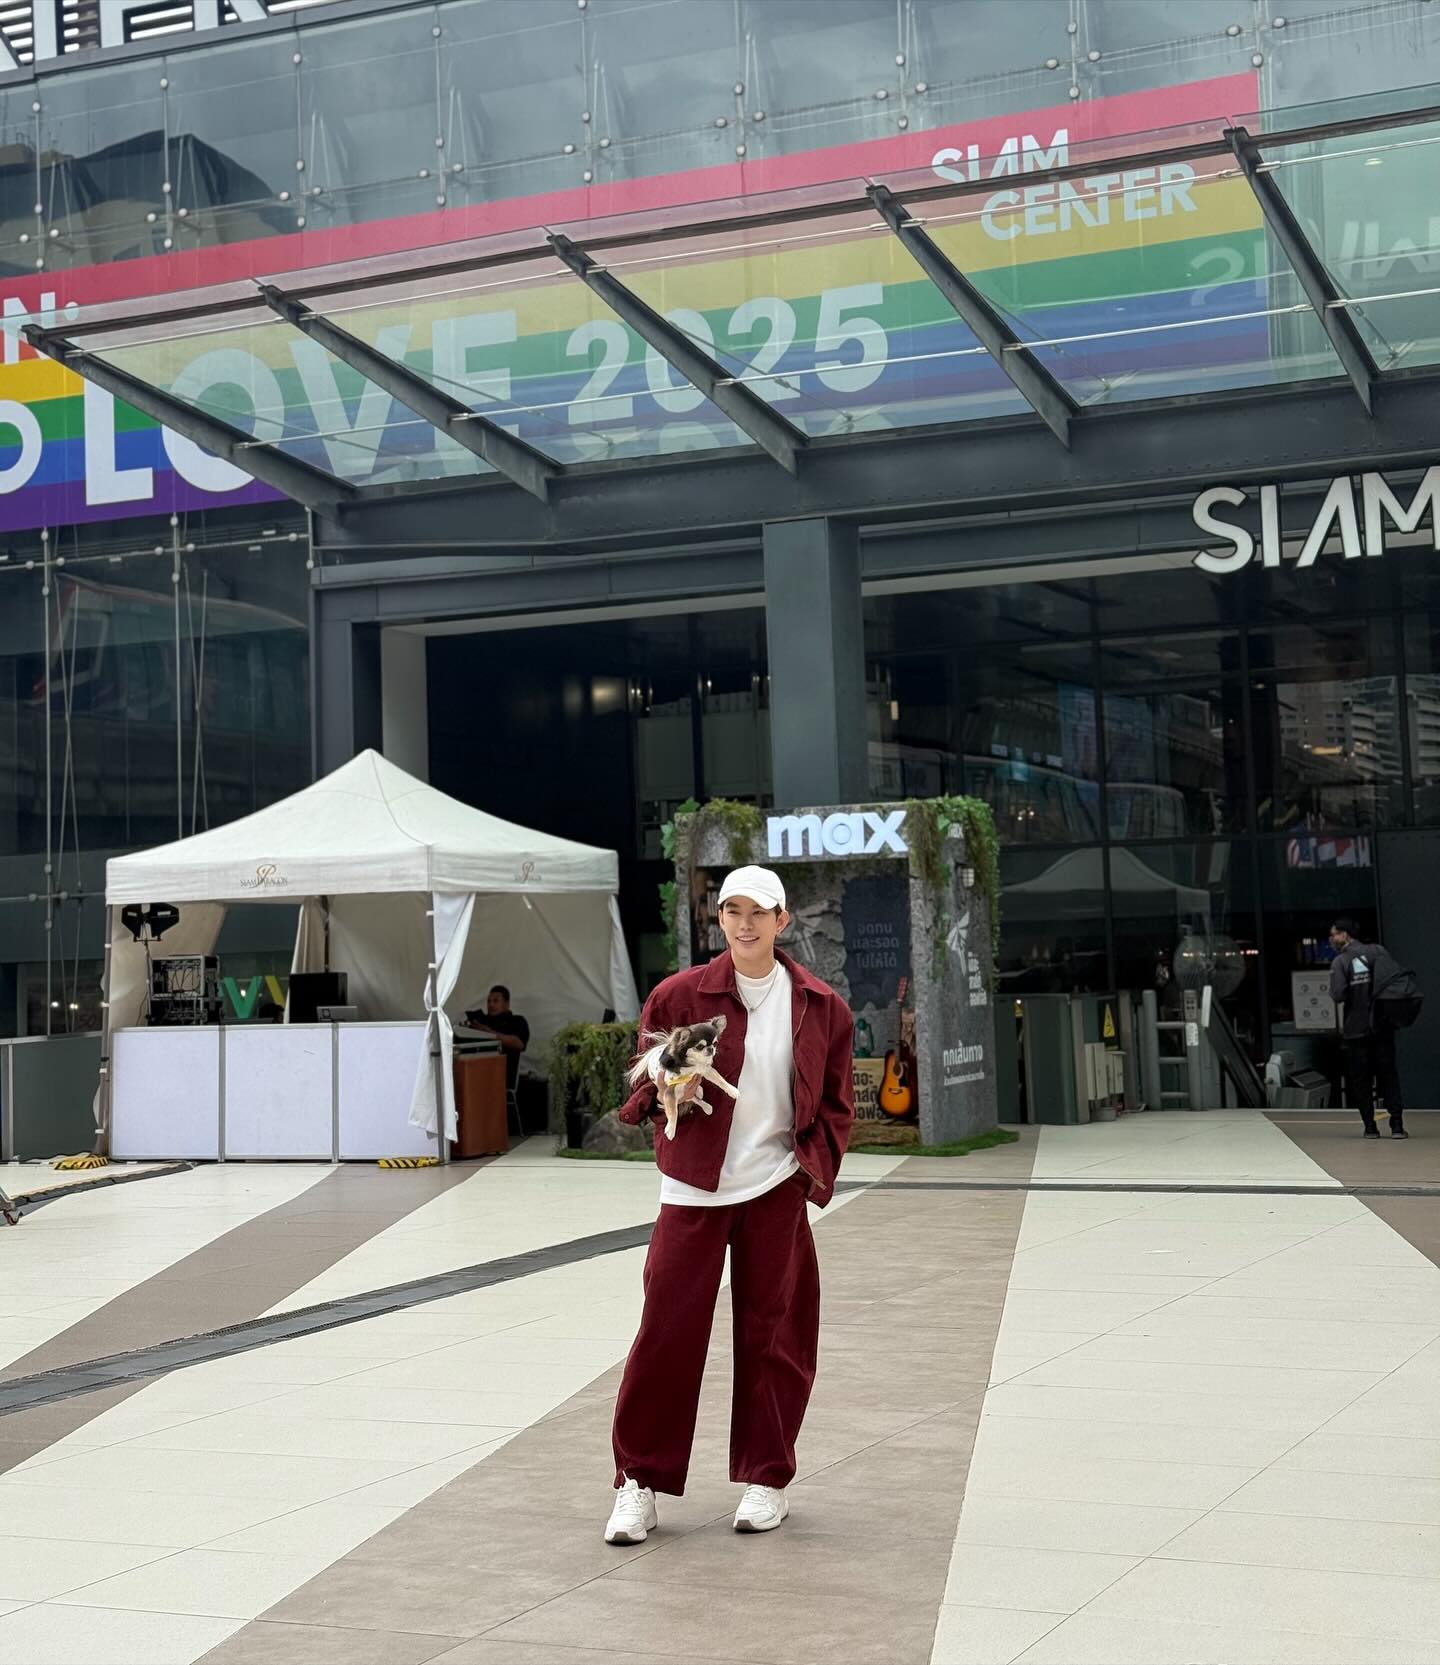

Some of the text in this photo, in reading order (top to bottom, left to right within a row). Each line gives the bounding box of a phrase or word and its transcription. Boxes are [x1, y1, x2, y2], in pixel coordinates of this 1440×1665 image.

[931, 128, 1069, 184] SIAM
[981, 163, 1199, 241] CENTER
[84, 310, 518, 506] LOVE
[566, 282, 888, 425] 2025
[1192, 465, 1440, 573] SIAM
[767, 811, 909, 857] max
